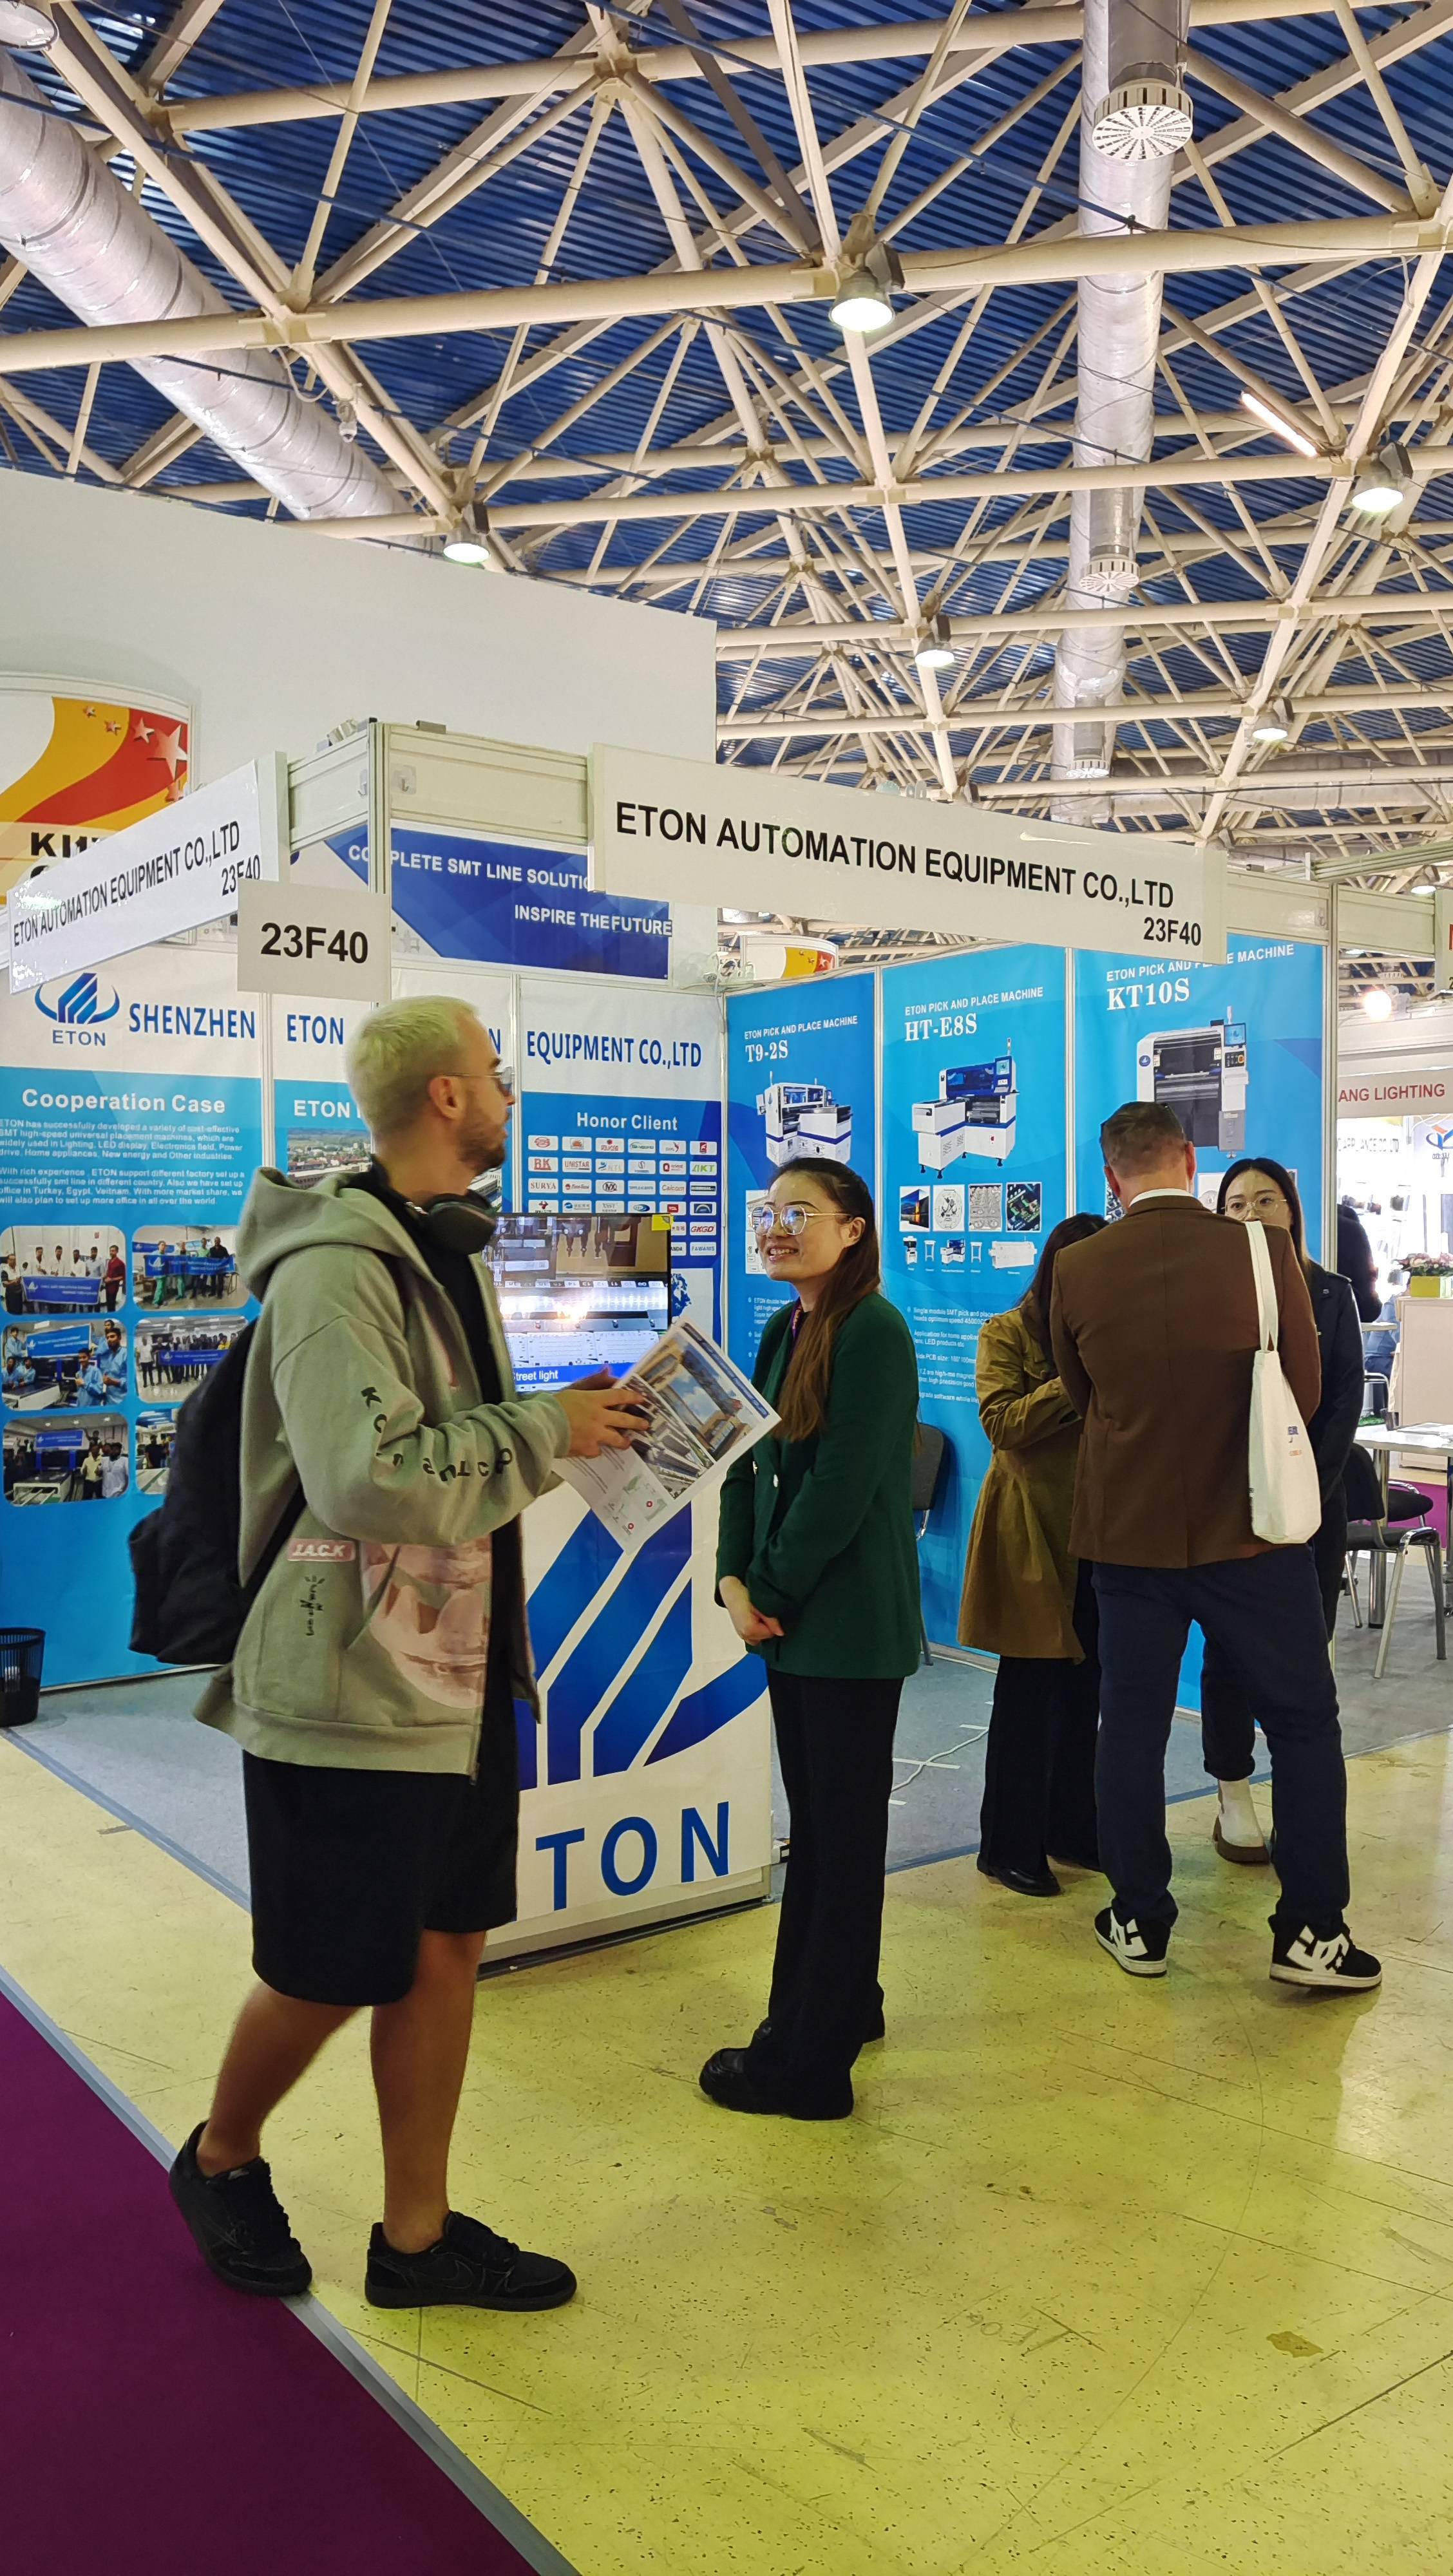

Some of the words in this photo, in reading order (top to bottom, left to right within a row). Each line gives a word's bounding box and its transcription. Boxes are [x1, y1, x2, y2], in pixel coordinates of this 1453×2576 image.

[348, 845, 442, 873] COPLETE
[447, 858, 481, 876] SMT
[487, 864, 522, 881] LINE
[616, 801, 706, 844] ETON
[716, 818, 915, 874] AUTOMATION
[926, 848, 1076, 895] EQUIPMENT
[1083, 872, 1173, 908] CO.,LTD
[14, 917, 38, 947] ETON
[41, 886, 108, 933] AUTOMATION
[110, 847, 180, 903] EQUIPMENT
[185, 821, 239, 871] CO.,LTD
[222, 855, 260, 896] 23F40
[515, 904, 575, 926] INSPIRE
[260, 922, 368, 964] 23F40
[1144, 917, 1201, 946] 23F40
[1238, 943, 1295, 962] MACHINE
[1106, 967, 1135, 981] ETON
[1139, 963, 1164, 977] PICK
[1168, 961, 1191, 972] AND
[905, 1005, 927, 1016] ETON
[929, 1001, 949, 1012] PICK
[951, 998, 969, 1009] AND
[971, 994, 999, 1006] PLACE
[1001, 987, 1043, 1002] MACHINE
[1106, 978, 1190, 1010] KT10S
[129, 1003, 255, 1039] SHENZHEN
[287, 1014, 344, 1045] ETON
[745, 1031, 762, 1040] ETON
[763, 1028, 779, 1037] PICK
[781, 1025, 796, 1034] AND
[798, 1021, 821, 1032] PLACE
[823, 1016, 858, 1029] MACHINE
[904, 1012, 977, 1041] HT-E8S
[52, 1030, 106, 1046] ETON
[527, 1030, 634, 1065] EQUIPMENT
[638, 1042, 702, 1070] CO.,LTD
[745, 1039, 788, 1063] T9-2S
[22, 1089, 166, 1112] Cooperation
[172, 1095, 226, 1113] Case
[1374, 1083, 1445, 1101] LIGHTING
[294, 1100, 350, 1118] ETON
[577, 1112, 627, 1128] Honor
[631, 1115, 678, 1131] Client
[513, 1371, 536, 1381] treet
[539, 1370, 559, 1382] light
[536, 1801, 729, 1911] TON
